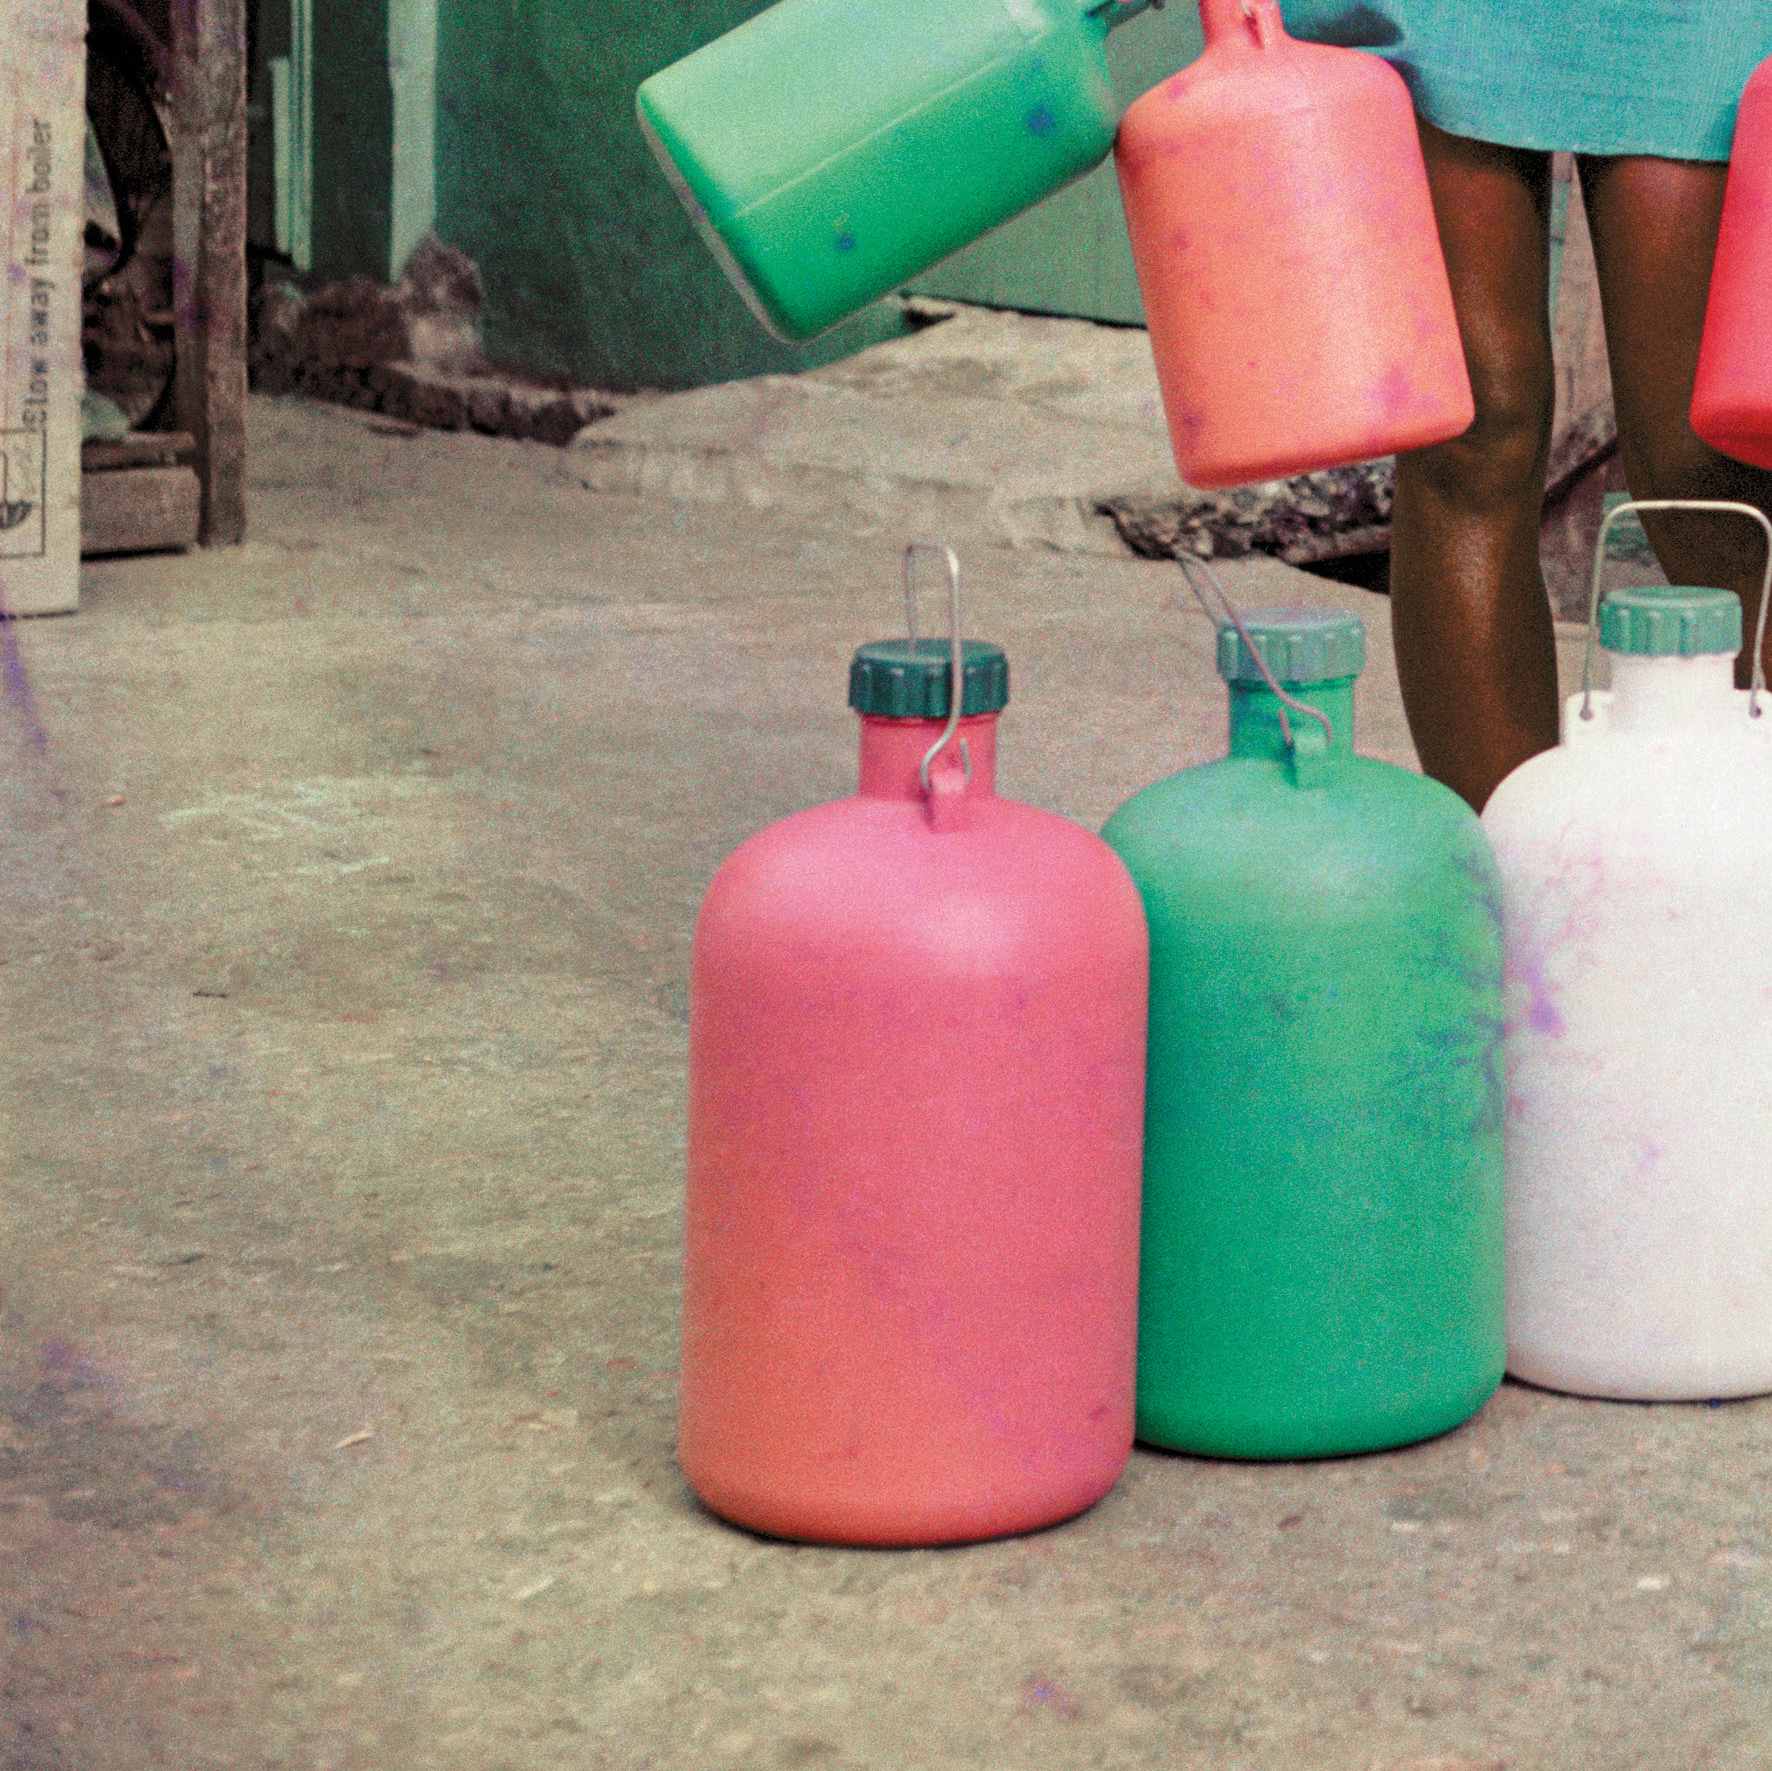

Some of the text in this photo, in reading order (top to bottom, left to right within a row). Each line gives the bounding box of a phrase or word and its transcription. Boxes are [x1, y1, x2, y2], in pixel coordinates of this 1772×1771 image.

[22, 117, 55, 425] Stow away from boiler
